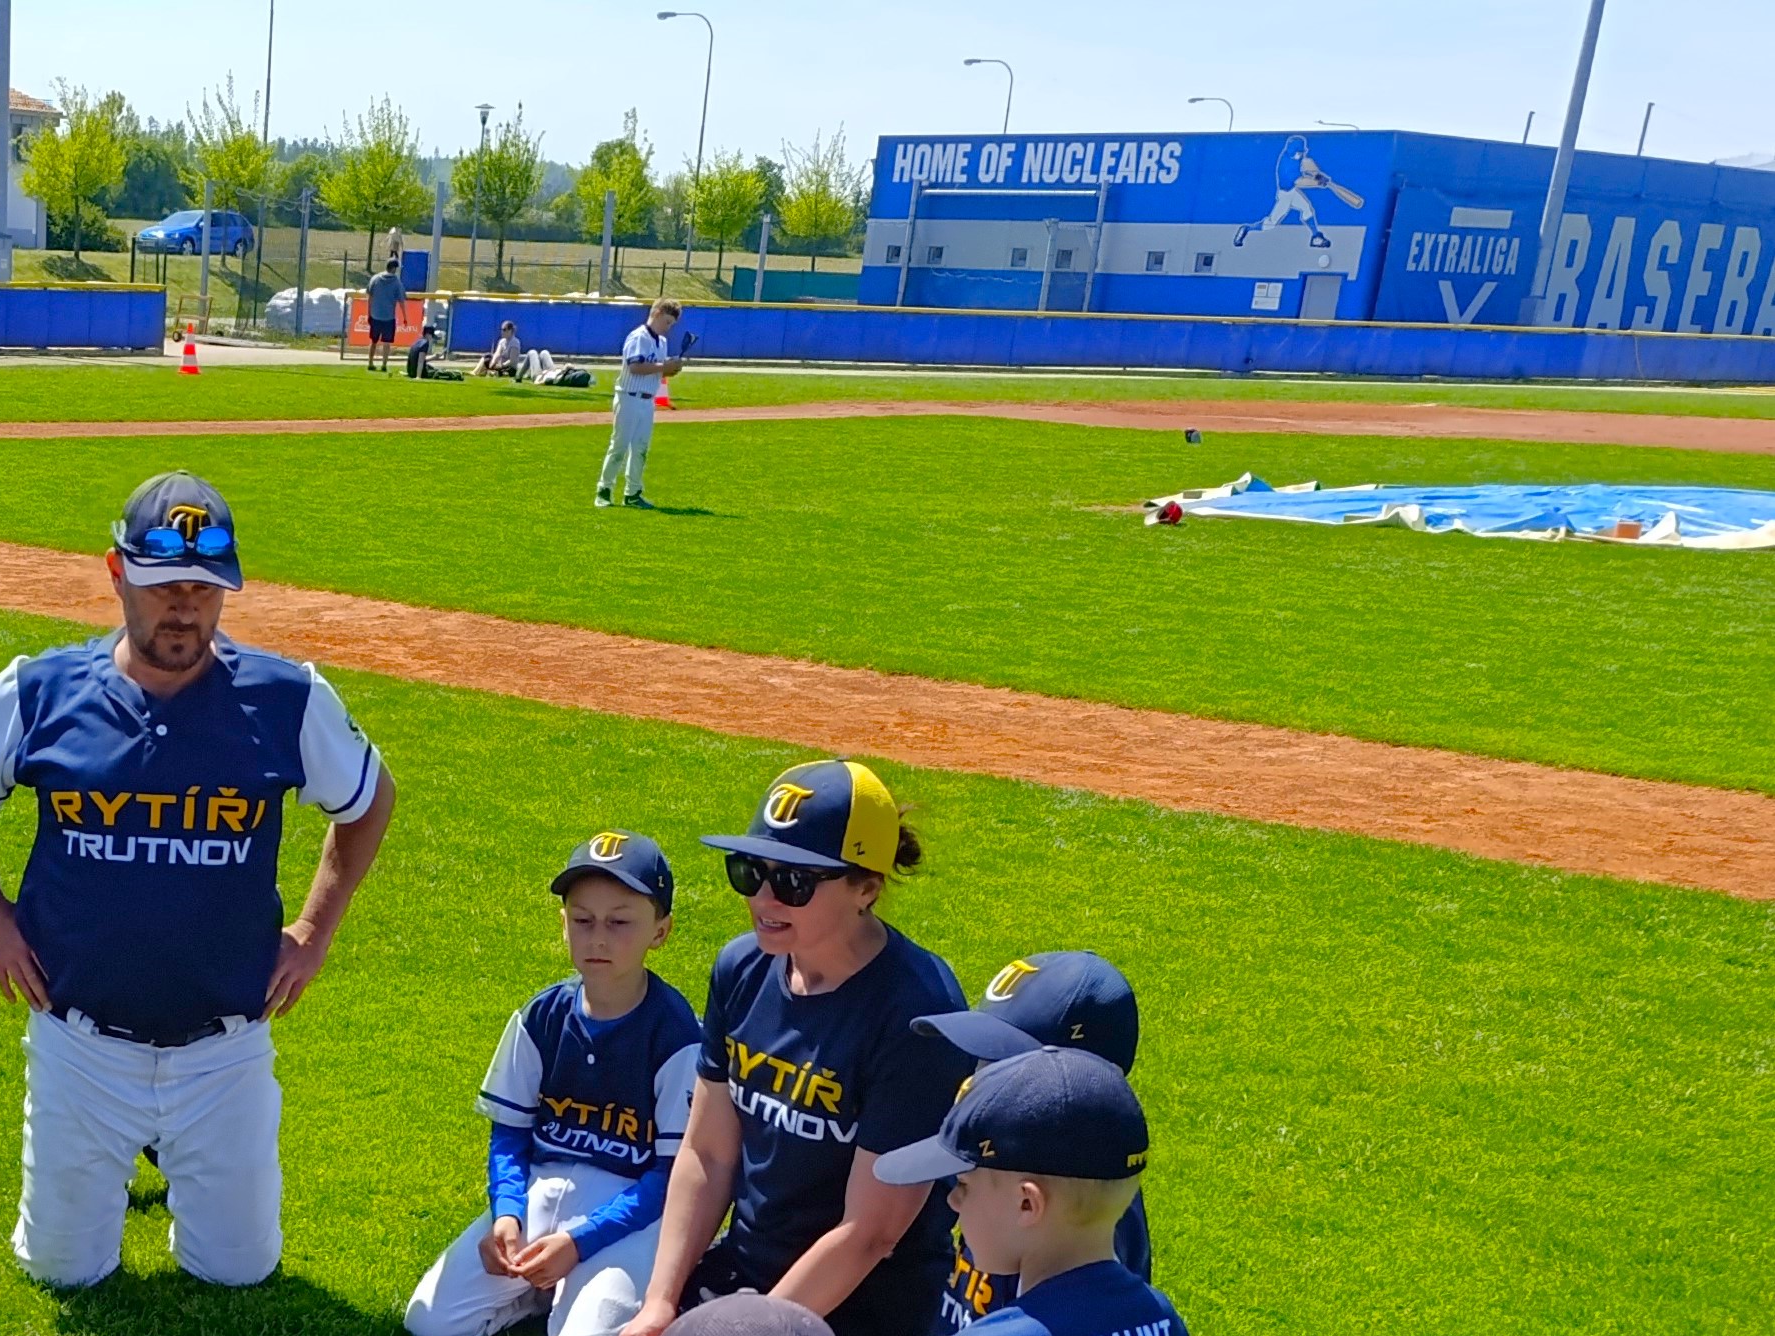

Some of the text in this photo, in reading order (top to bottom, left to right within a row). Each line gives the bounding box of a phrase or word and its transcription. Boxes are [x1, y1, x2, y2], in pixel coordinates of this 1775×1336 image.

[892, 141, 1182, 185] HOME OF NUCLEARS
[1406, 231, 1521, 276] EXTRALIGA
[1544, 212, 1775, 337] BASEB
[50, 786, 266, 832] RYTÍŘI
[62, 829, 253, 866] TRUTNOV
